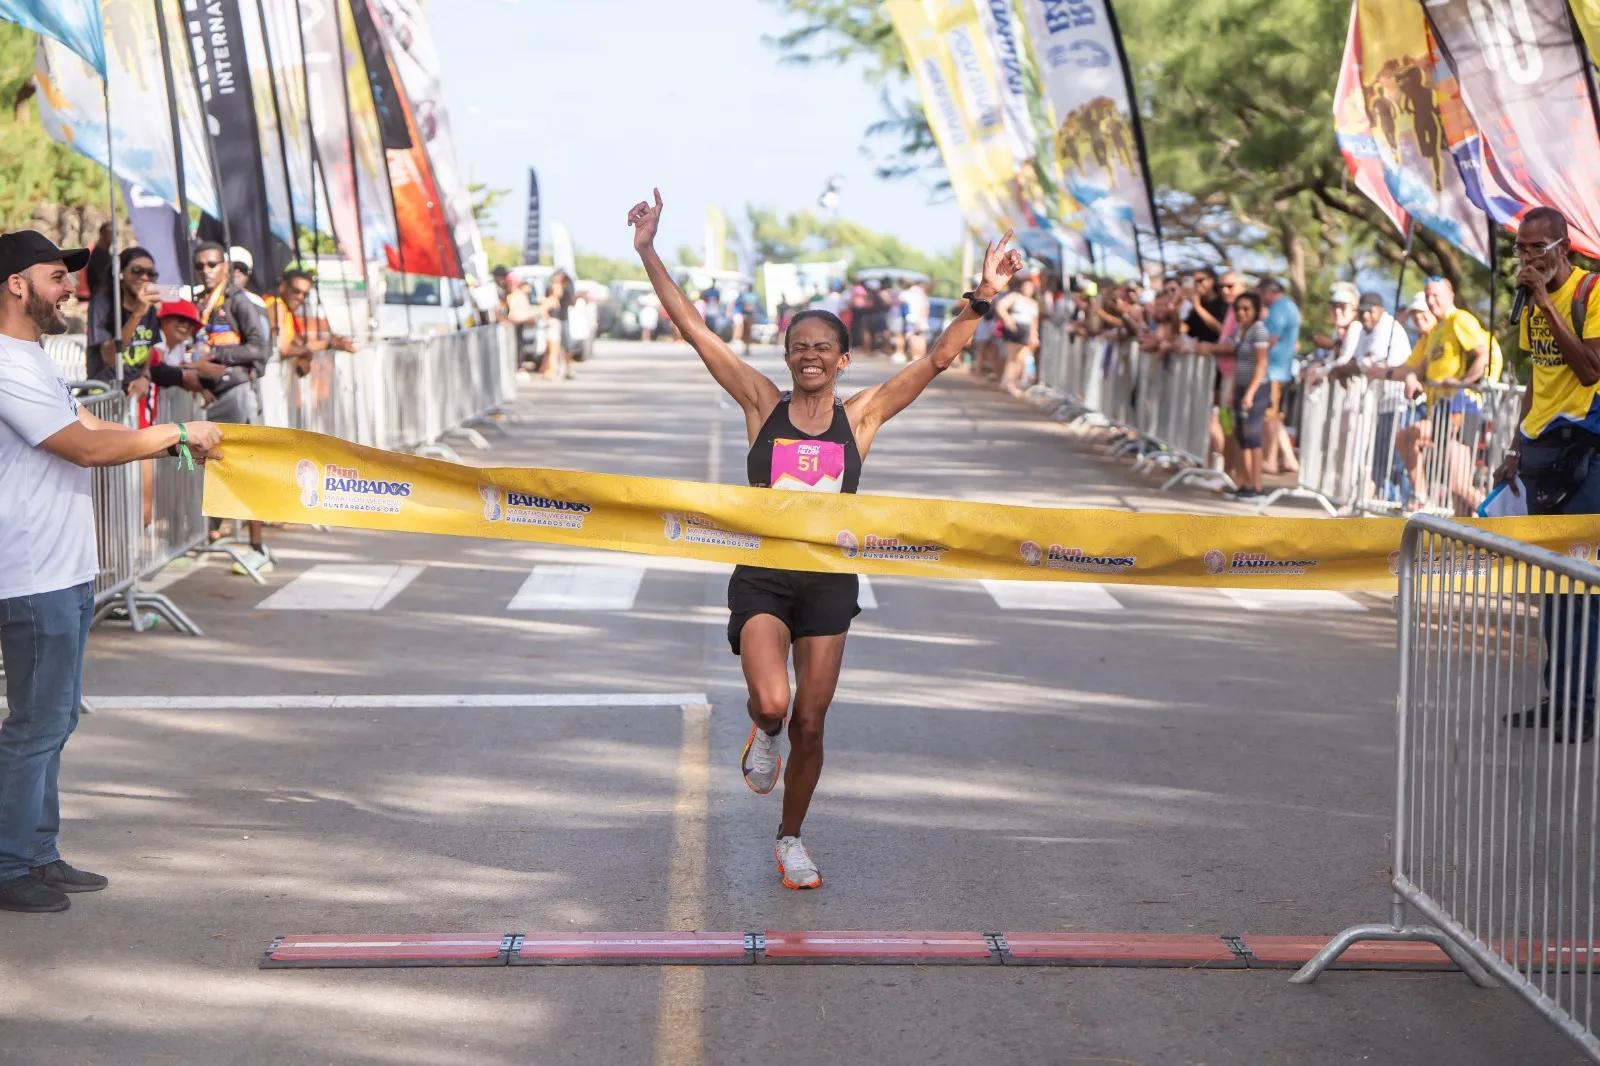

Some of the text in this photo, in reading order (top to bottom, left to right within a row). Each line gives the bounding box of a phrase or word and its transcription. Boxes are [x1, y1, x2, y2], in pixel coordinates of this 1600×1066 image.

[797, 455, 818, 472] 51
[325, 464, 358, 479] Run
[325, 478, 411, 497] BARBADOS
[323, 495, 402, 507] MARATHON WEEKEND
[323, 502, 400, 513] RUNBARBADOS.ORG
[508, 493, 591, 513] BARBADOS
[507, 508, 584, 522] MARATHON WEEKEND
[506, 516, 582, 529] RUNBARBADOS.ORG
[685, 535, 760, 549] RUNBARBADOS.ORG
[865, 534, 898, 547] Run
[1050, 545, 1083, 556] Run
[1233, 552, 1266, 561] Run
[1048, 553, 1134, 566] BARBADOS
